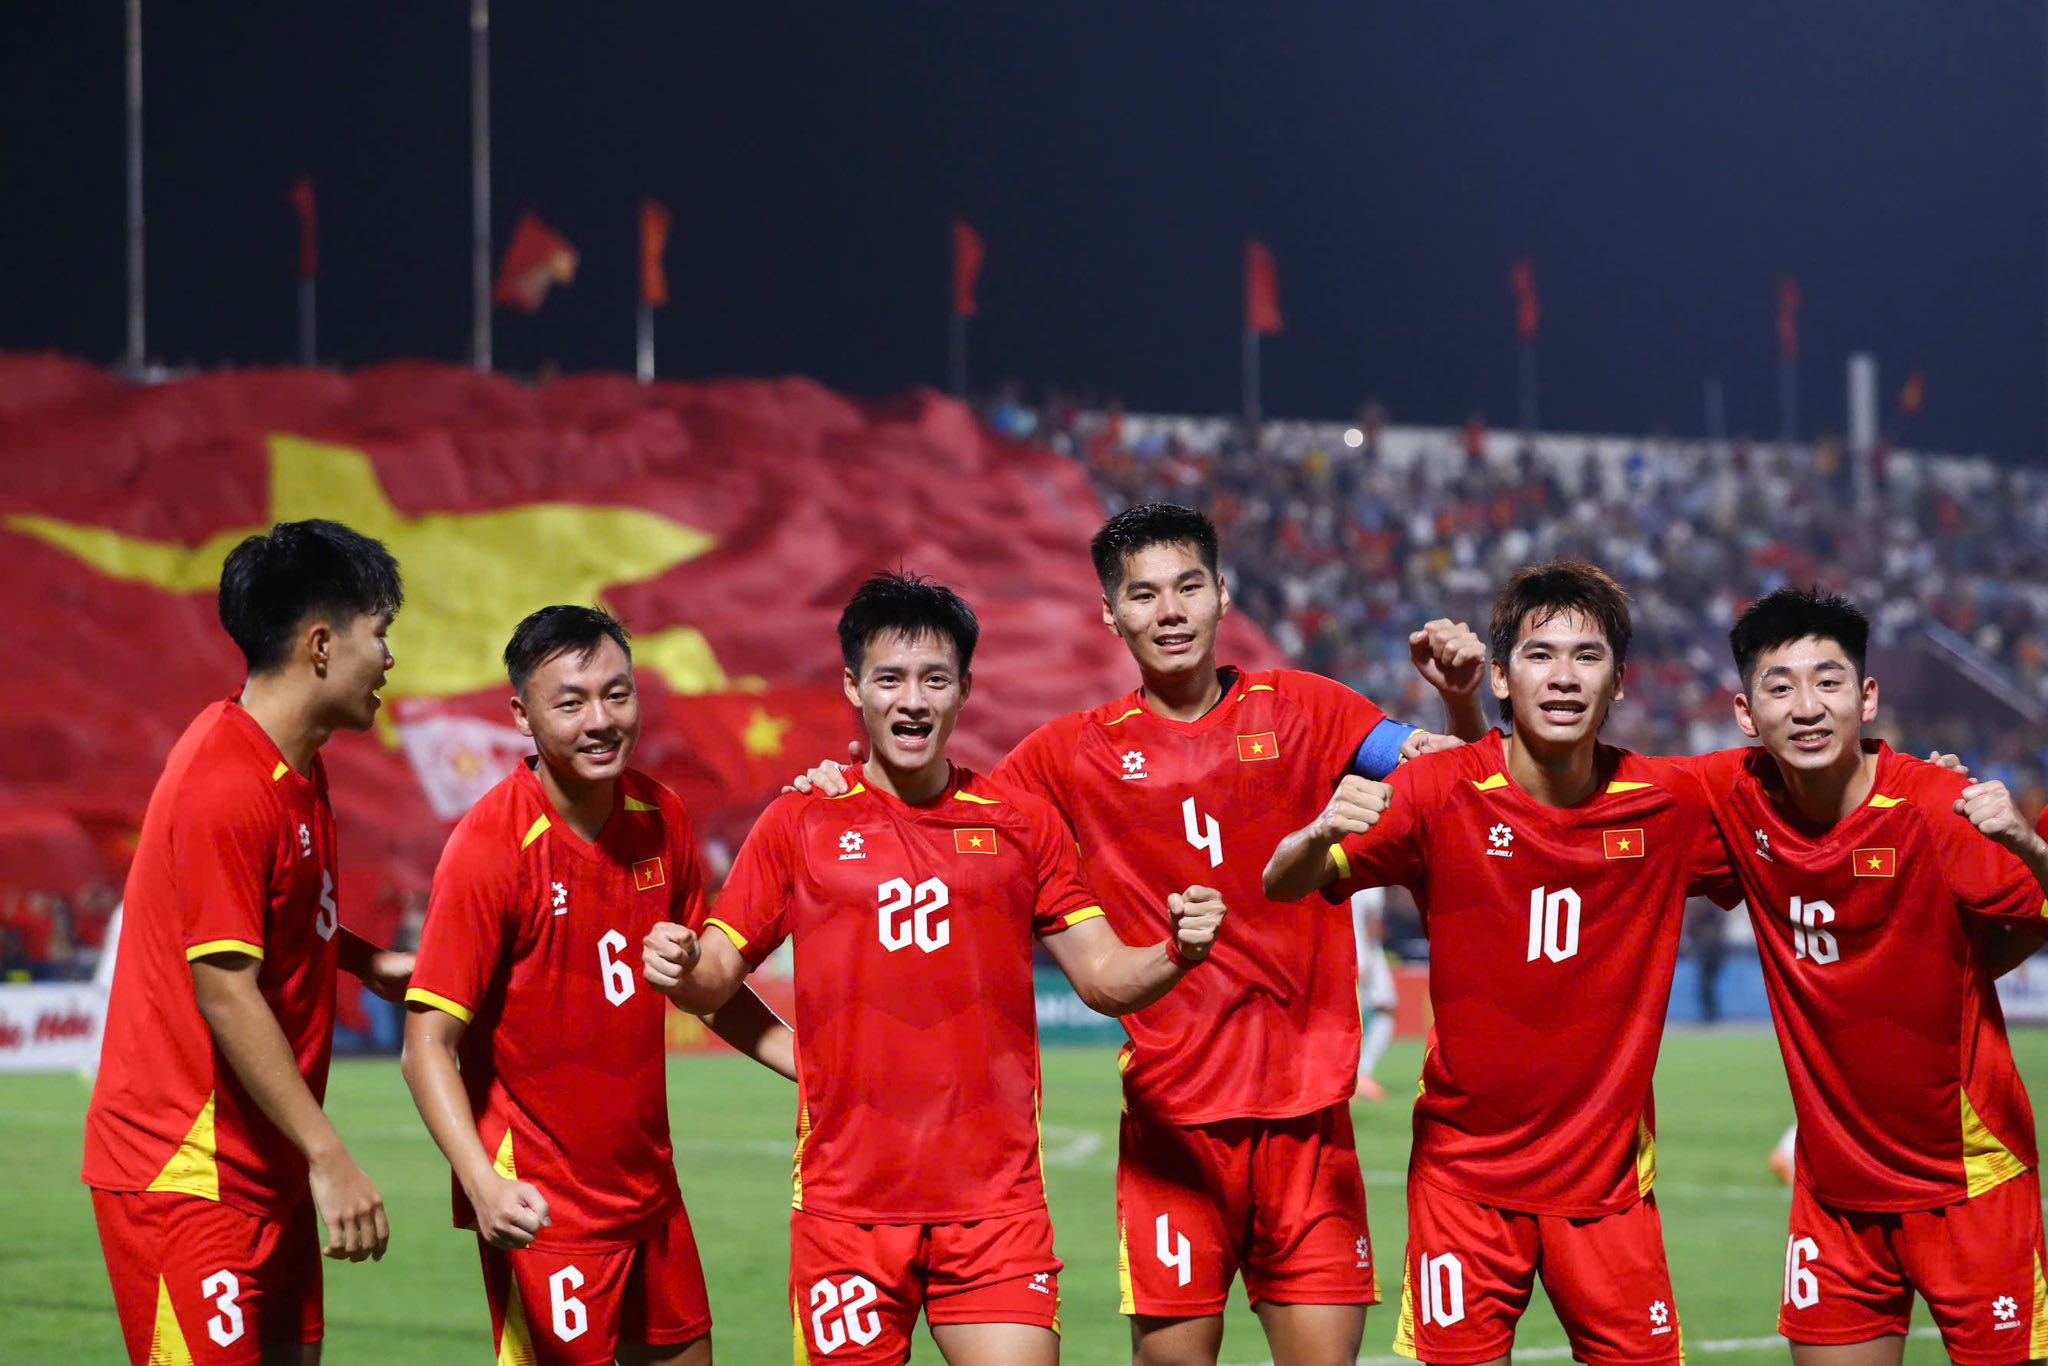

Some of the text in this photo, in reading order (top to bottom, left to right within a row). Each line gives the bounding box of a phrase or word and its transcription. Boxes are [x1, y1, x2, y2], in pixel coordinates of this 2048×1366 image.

[1182, 797, 1223, 868] 4
[877, 877, 949, 954] 22
[1527, 886, 1581, 964] 10
[1789, 895, 1840, 966] 16
[597, 929, 635, 1007] 6
[1156, 1214, 1191, 1287] 4
[1782, 1233, 1820, 1310] 16
[201, 1269, 245, 1348] 3
[549, 1265, 588, 1343] 6
[810, 1275, 882, 1355] 22
[1420, 1252, 1465, 1329] 10
